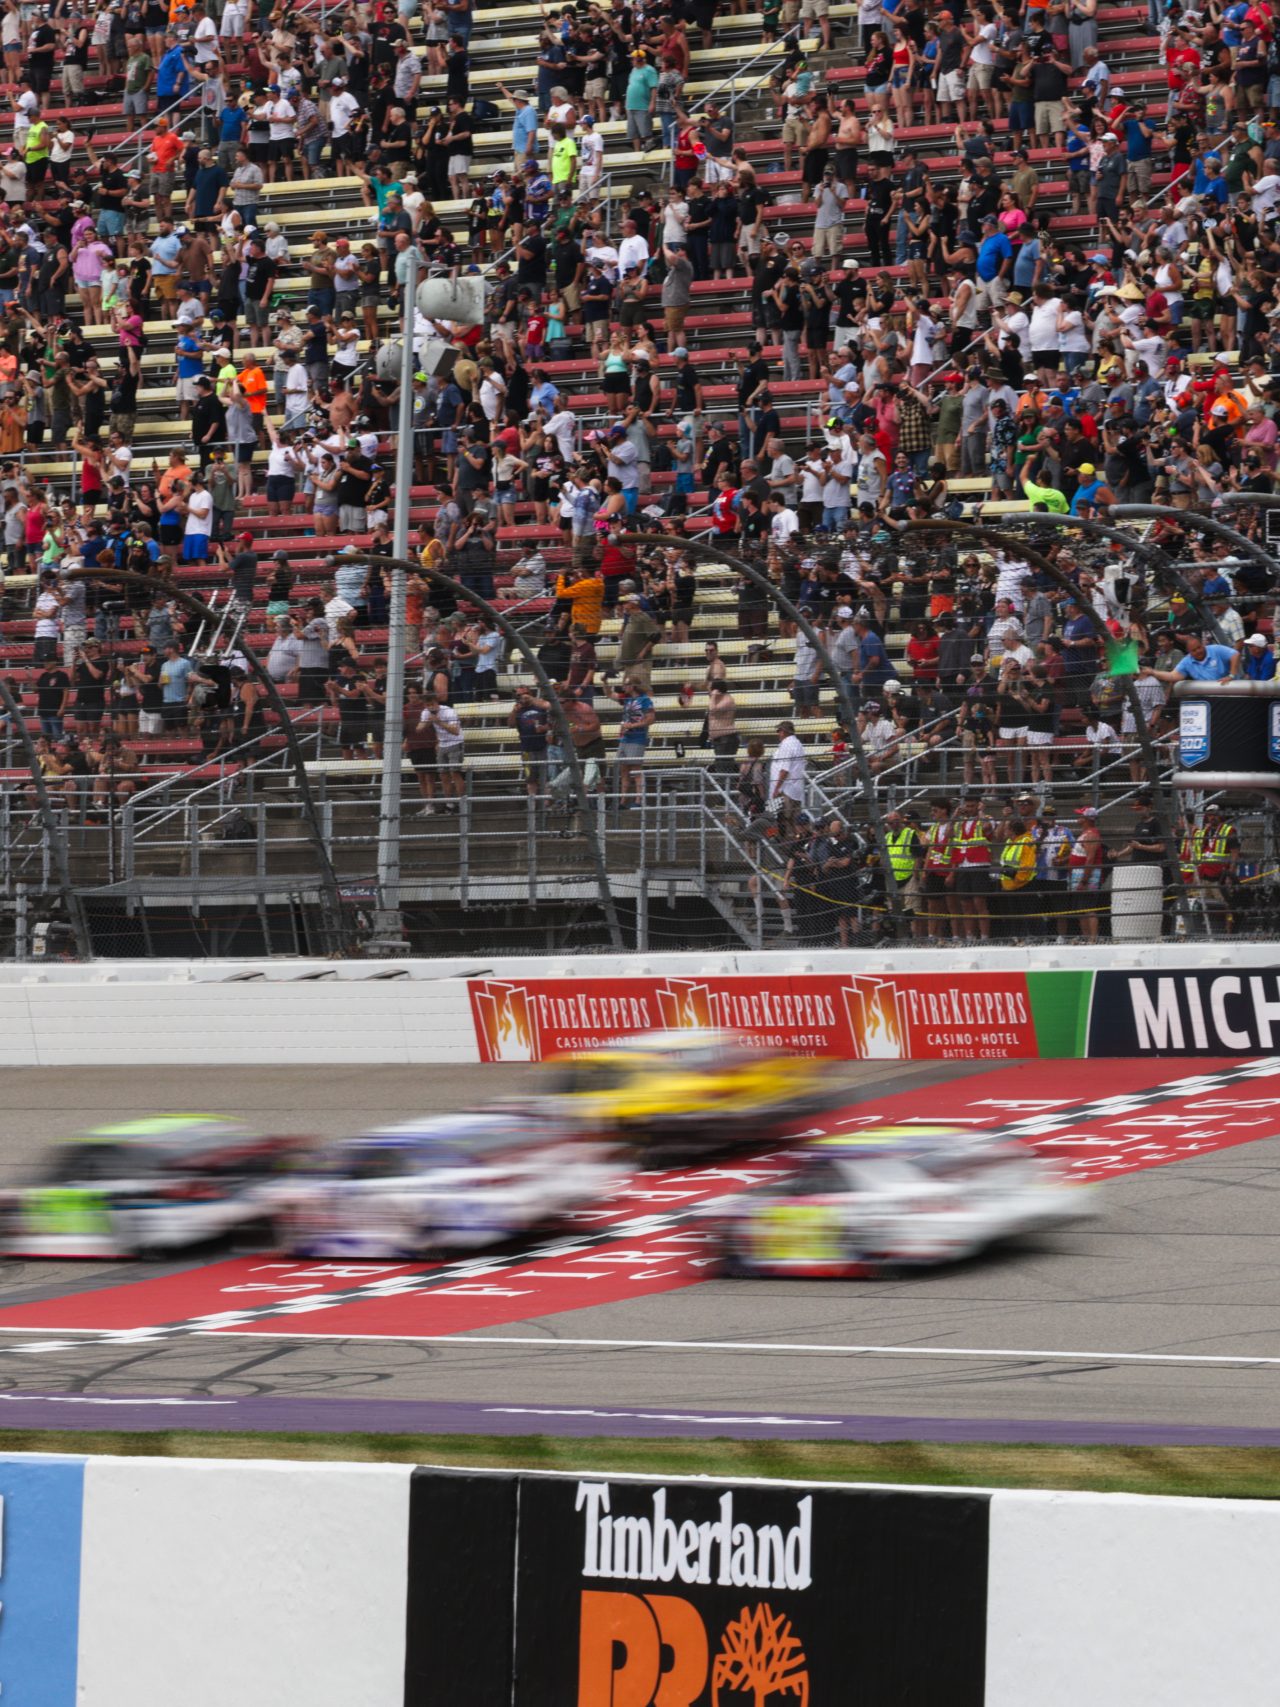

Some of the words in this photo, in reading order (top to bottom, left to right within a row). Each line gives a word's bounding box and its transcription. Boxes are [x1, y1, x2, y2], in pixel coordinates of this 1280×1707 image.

[556, 1036, 600, 1049] CASINO
[738, 1034, 783, 1047] CASINO
[791, 1034, 828, 1047] HOTEL
[927, 1033, 973, 1046] CASINO
[981, 1033, 1020, 1045] HOTEL
[942, 1048, 975, 1058] BATTLE
[979, 1048, 1008, 1058] CREEK
[575, 1480, 813, 1590] Timberland
